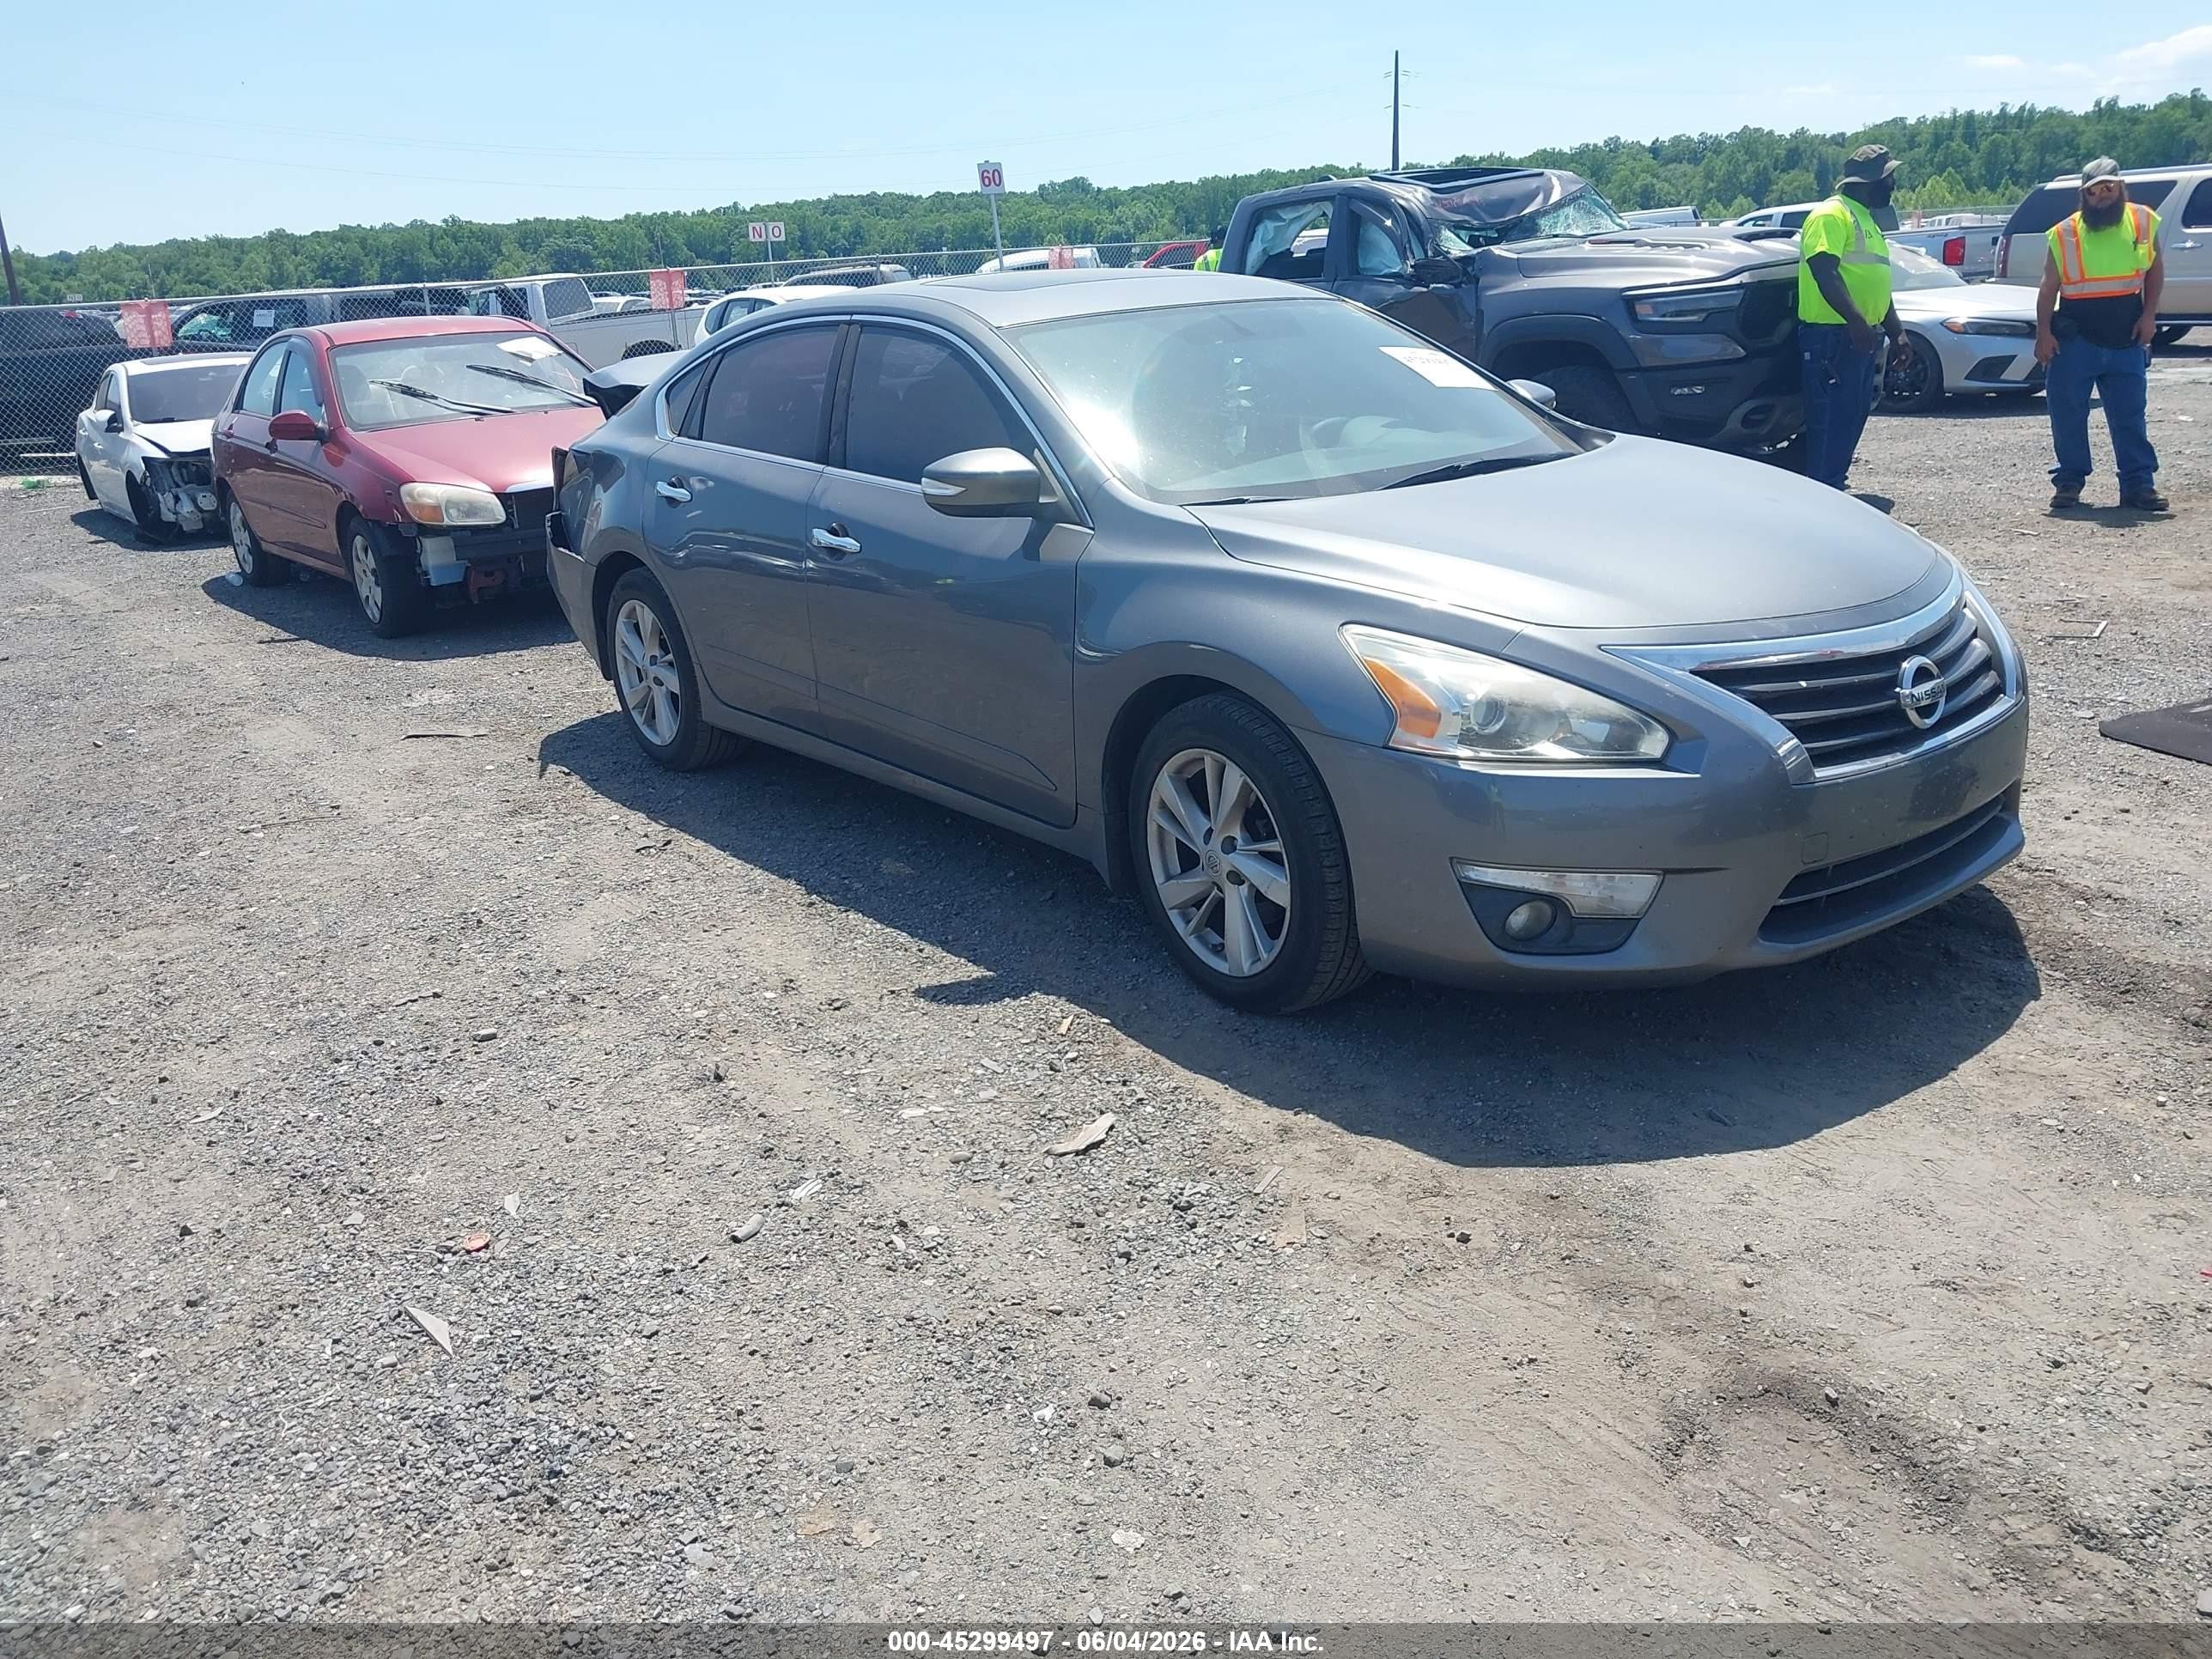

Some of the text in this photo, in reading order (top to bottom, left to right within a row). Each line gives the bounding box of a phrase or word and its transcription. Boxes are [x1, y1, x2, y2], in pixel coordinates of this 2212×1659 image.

[981, 168, 1001, 187] 60
[752, 225, 781, 239] N O
